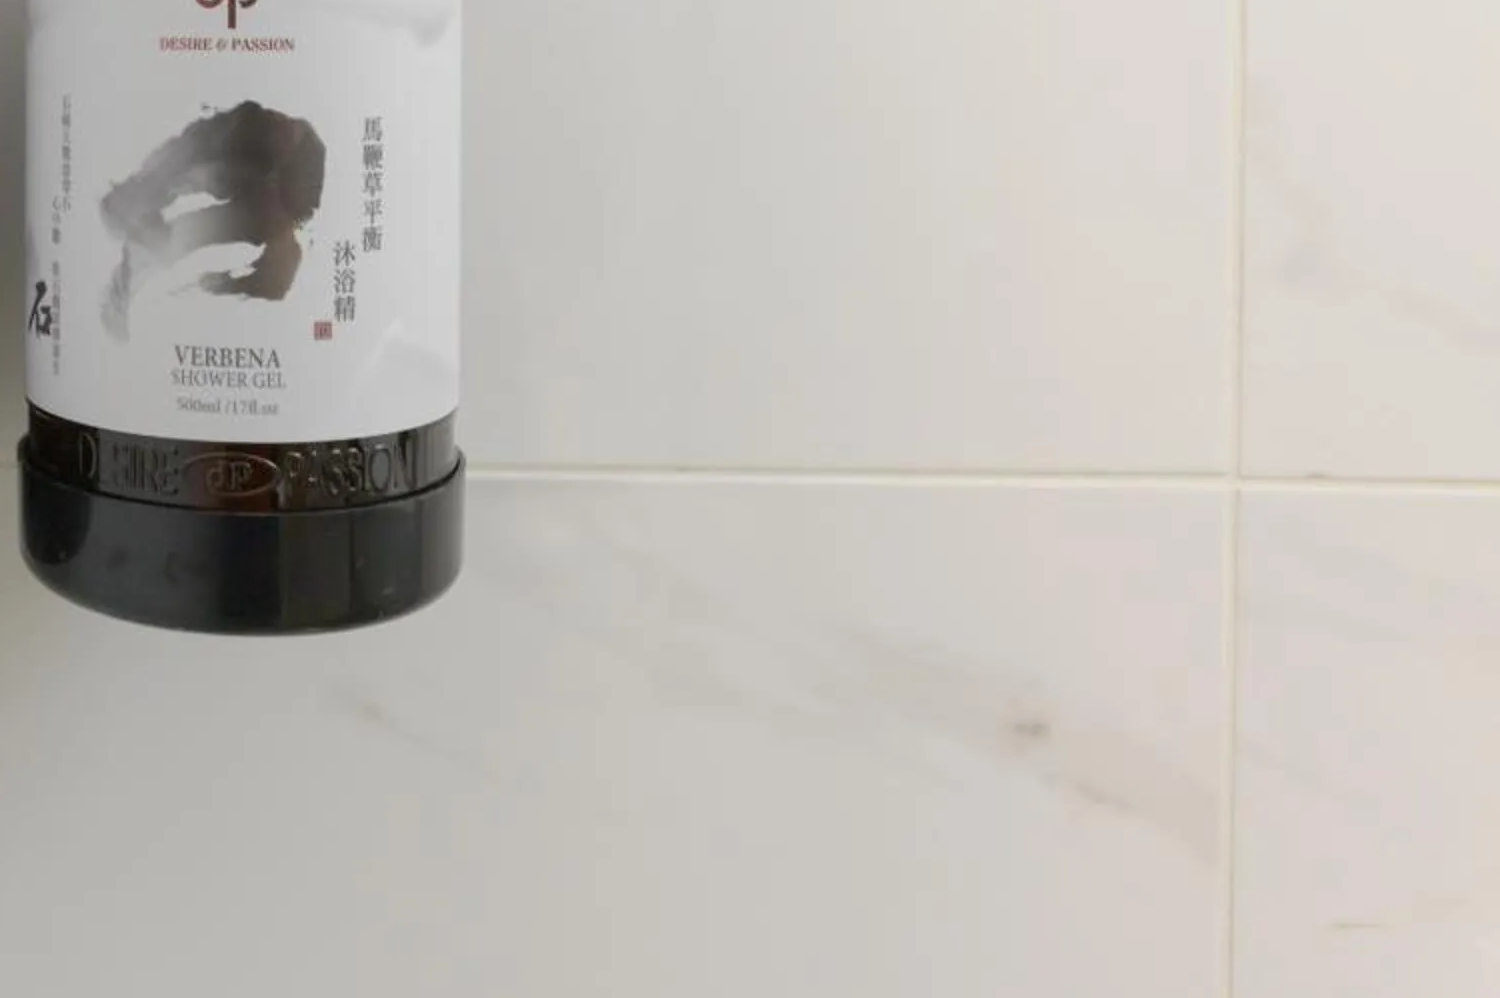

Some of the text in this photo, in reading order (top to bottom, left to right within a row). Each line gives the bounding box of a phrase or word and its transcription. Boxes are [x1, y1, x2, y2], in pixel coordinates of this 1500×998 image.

[160, 38, 212, 50] DESIRE
[231, 38, 295, 51] PASSION
[362, 117, 383, 251] 馬鞭草平衡
[333, 240, 355, 322] 沐浴精
[175, 345, 280, 369] VERBENA
[171, 369, 286, 389] SHOWER GEL
[177, 397, 220, 413] 500ml
[78, 432, 179, 496] DSIRE
